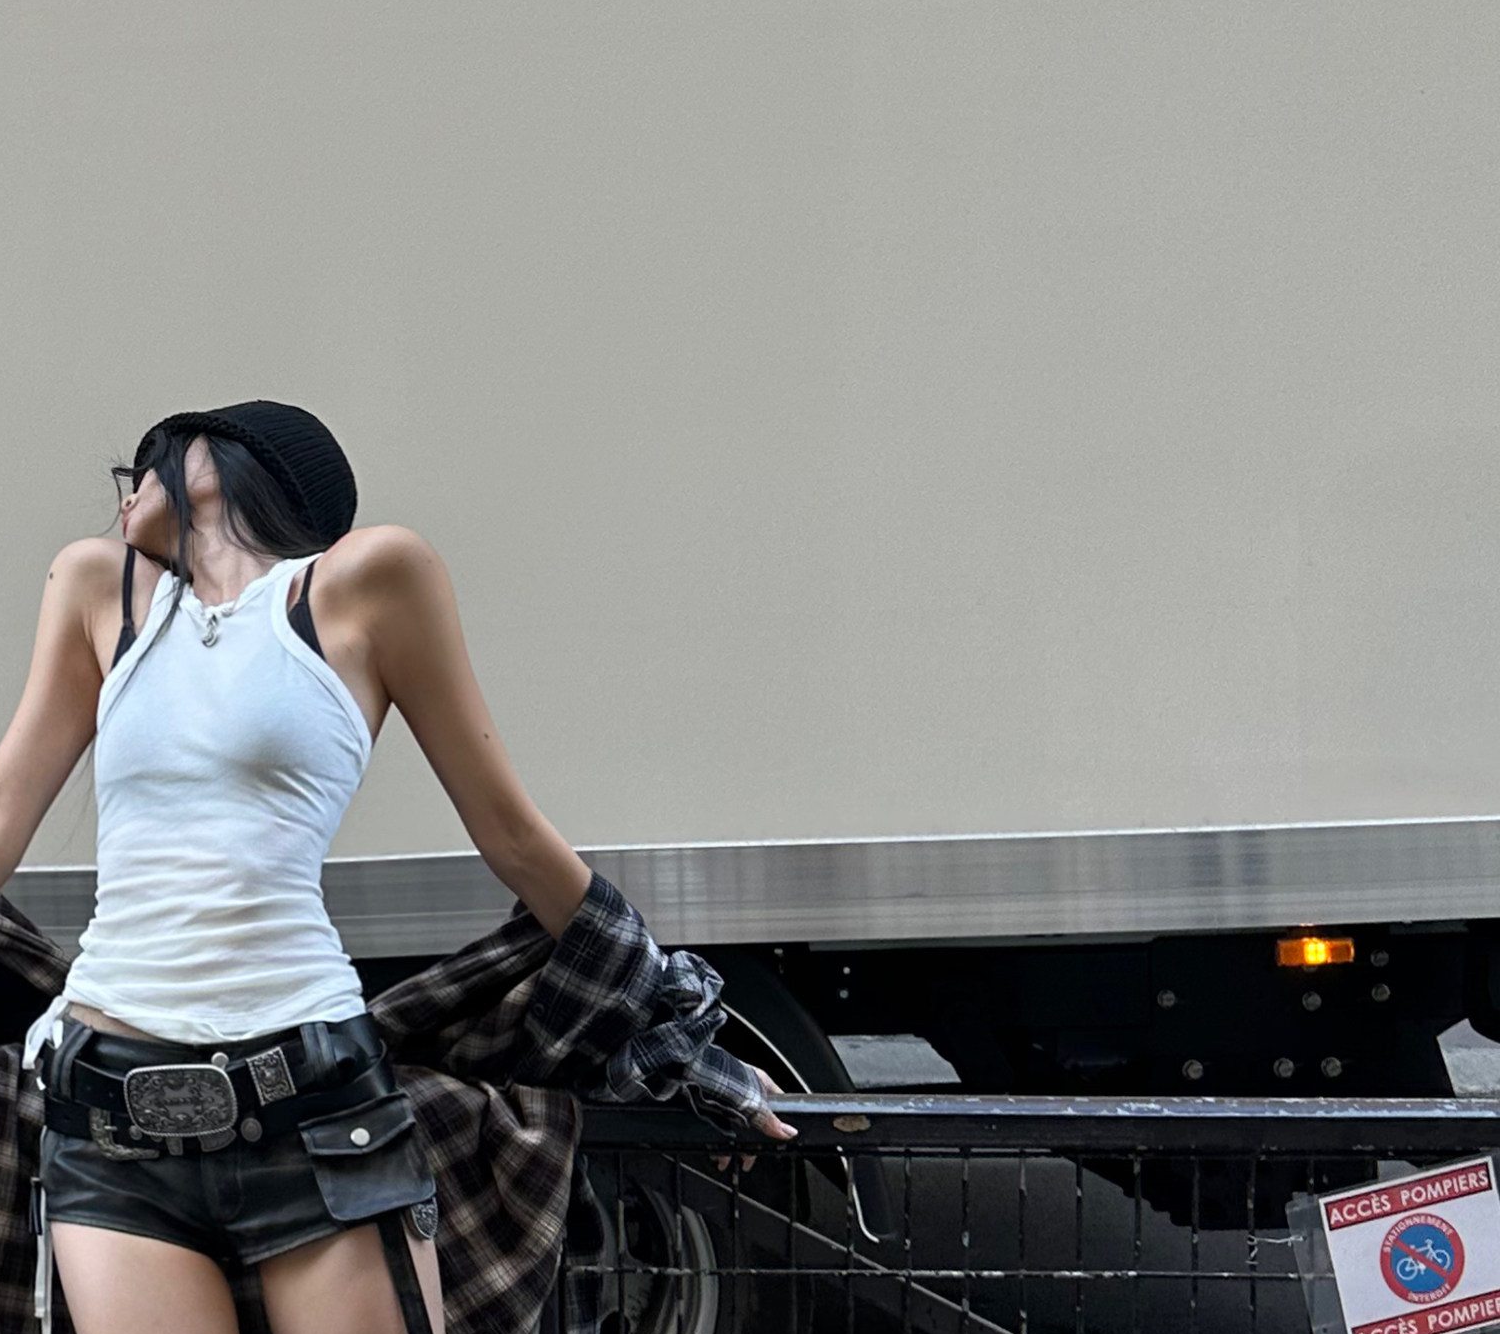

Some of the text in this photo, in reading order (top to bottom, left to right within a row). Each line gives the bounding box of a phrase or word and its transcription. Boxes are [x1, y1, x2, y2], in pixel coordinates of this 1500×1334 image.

[1329, 1170, 1488, 1225] ACCÈS POMPIERS
[1383, 1217, 1454, 1254] STATIONNEMENT
[1408, 1283, 1452, 1302] INTERDIT
